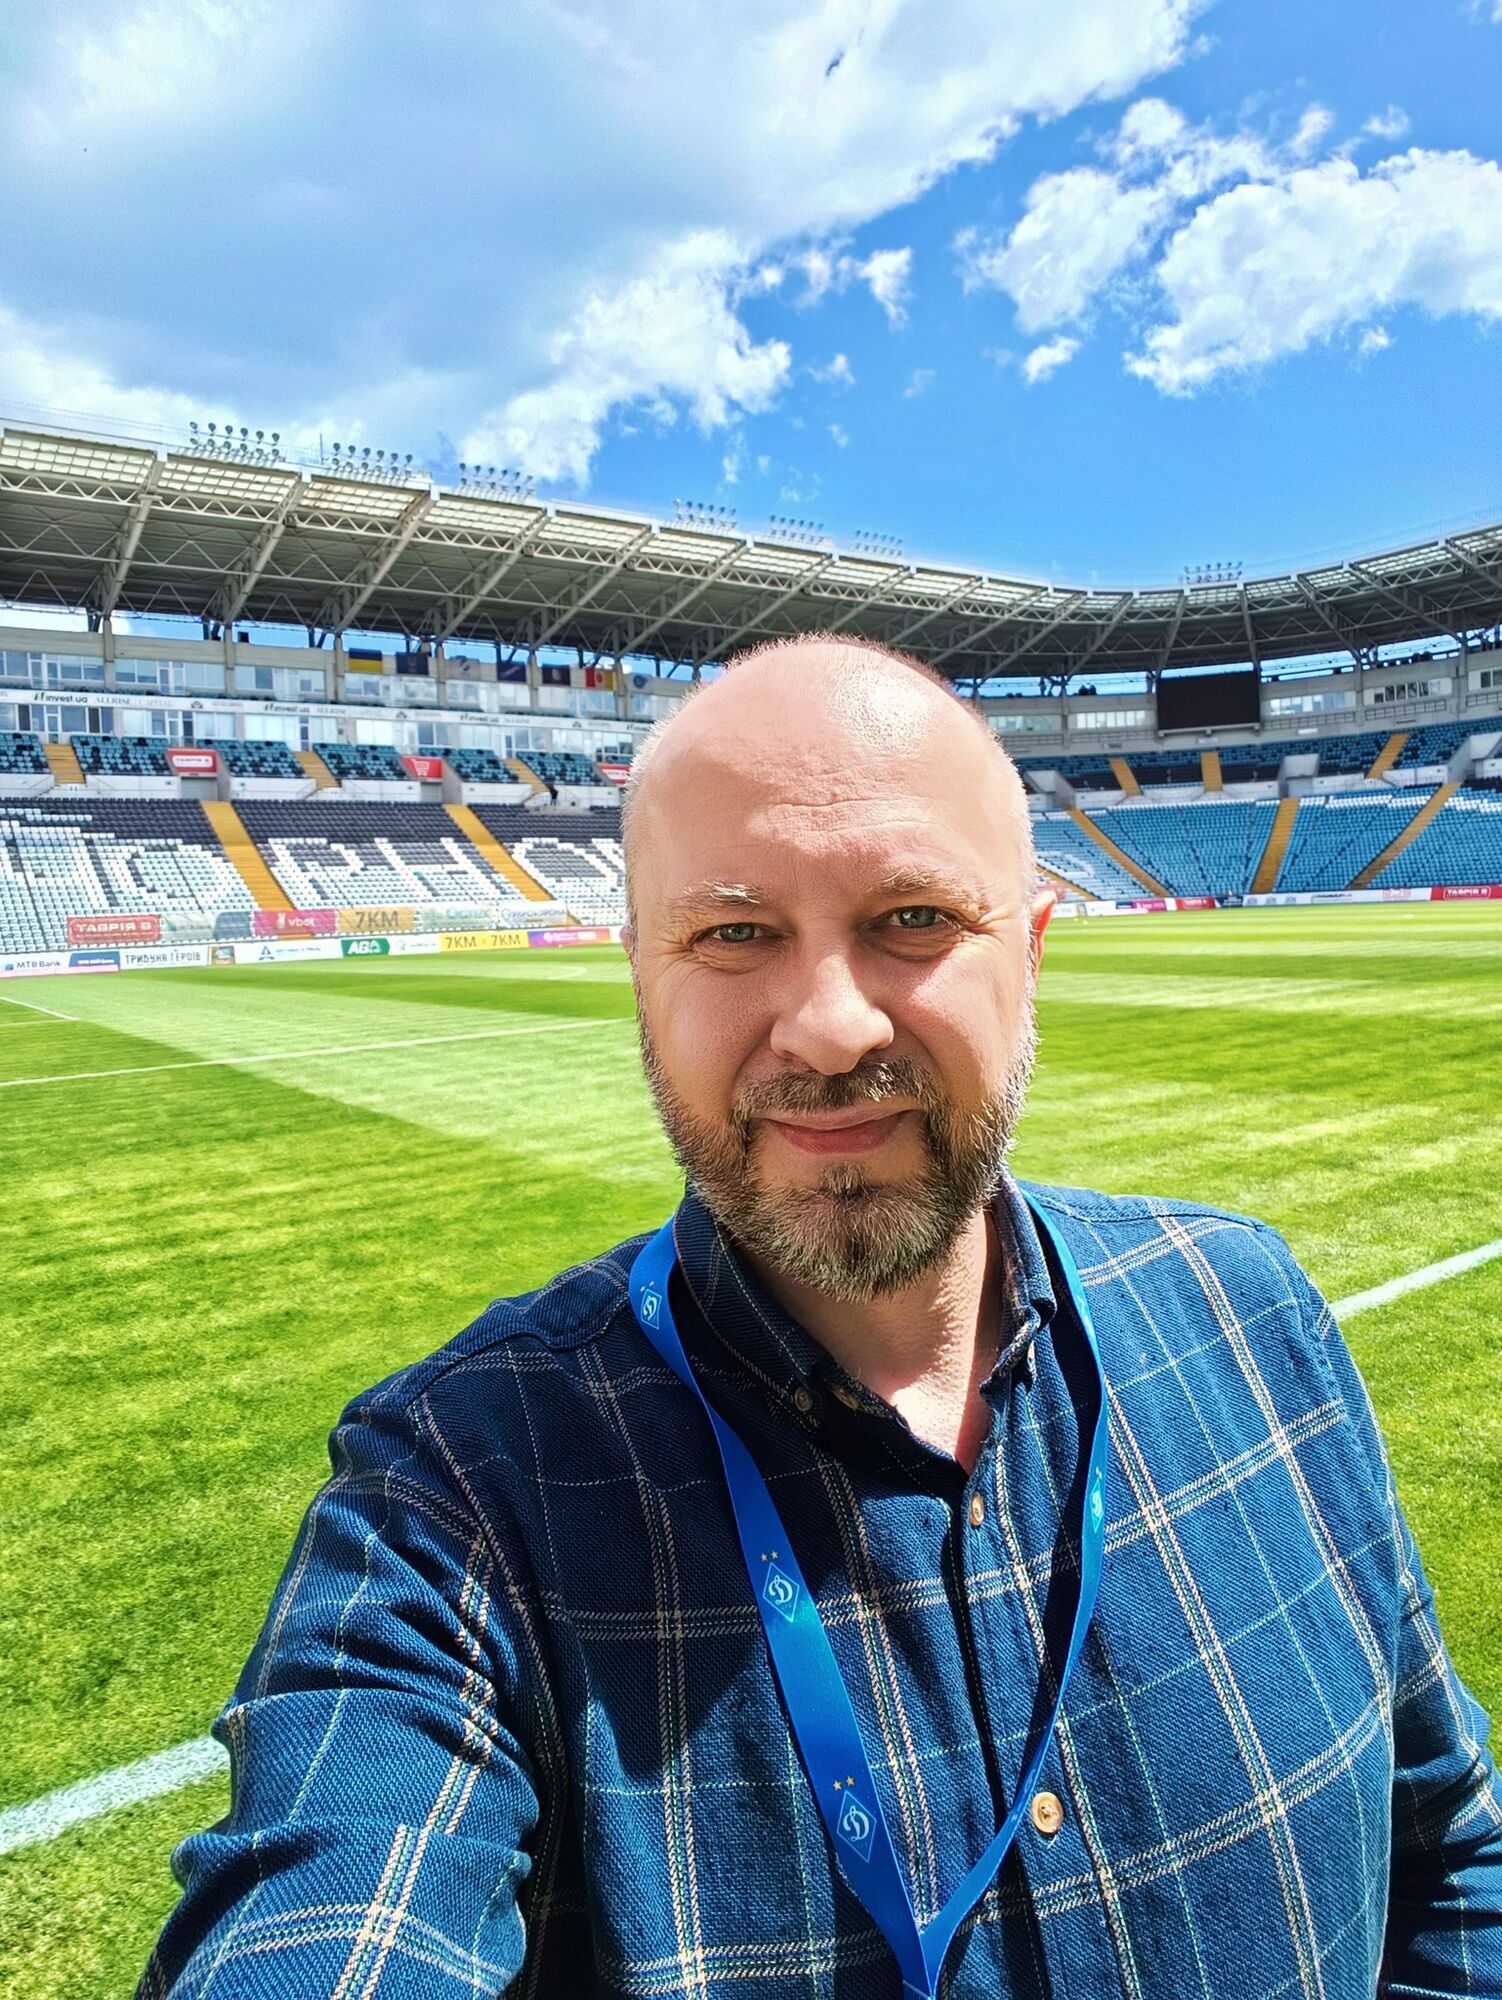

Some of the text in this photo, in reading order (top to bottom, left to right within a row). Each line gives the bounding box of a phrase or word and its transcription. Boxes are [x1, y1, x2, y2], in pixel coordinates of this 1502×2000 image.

[445, 936, 477, 949] 7KM
[490, 934, 521, 947] 7KM
[39, 960, 61, 968] Bank
